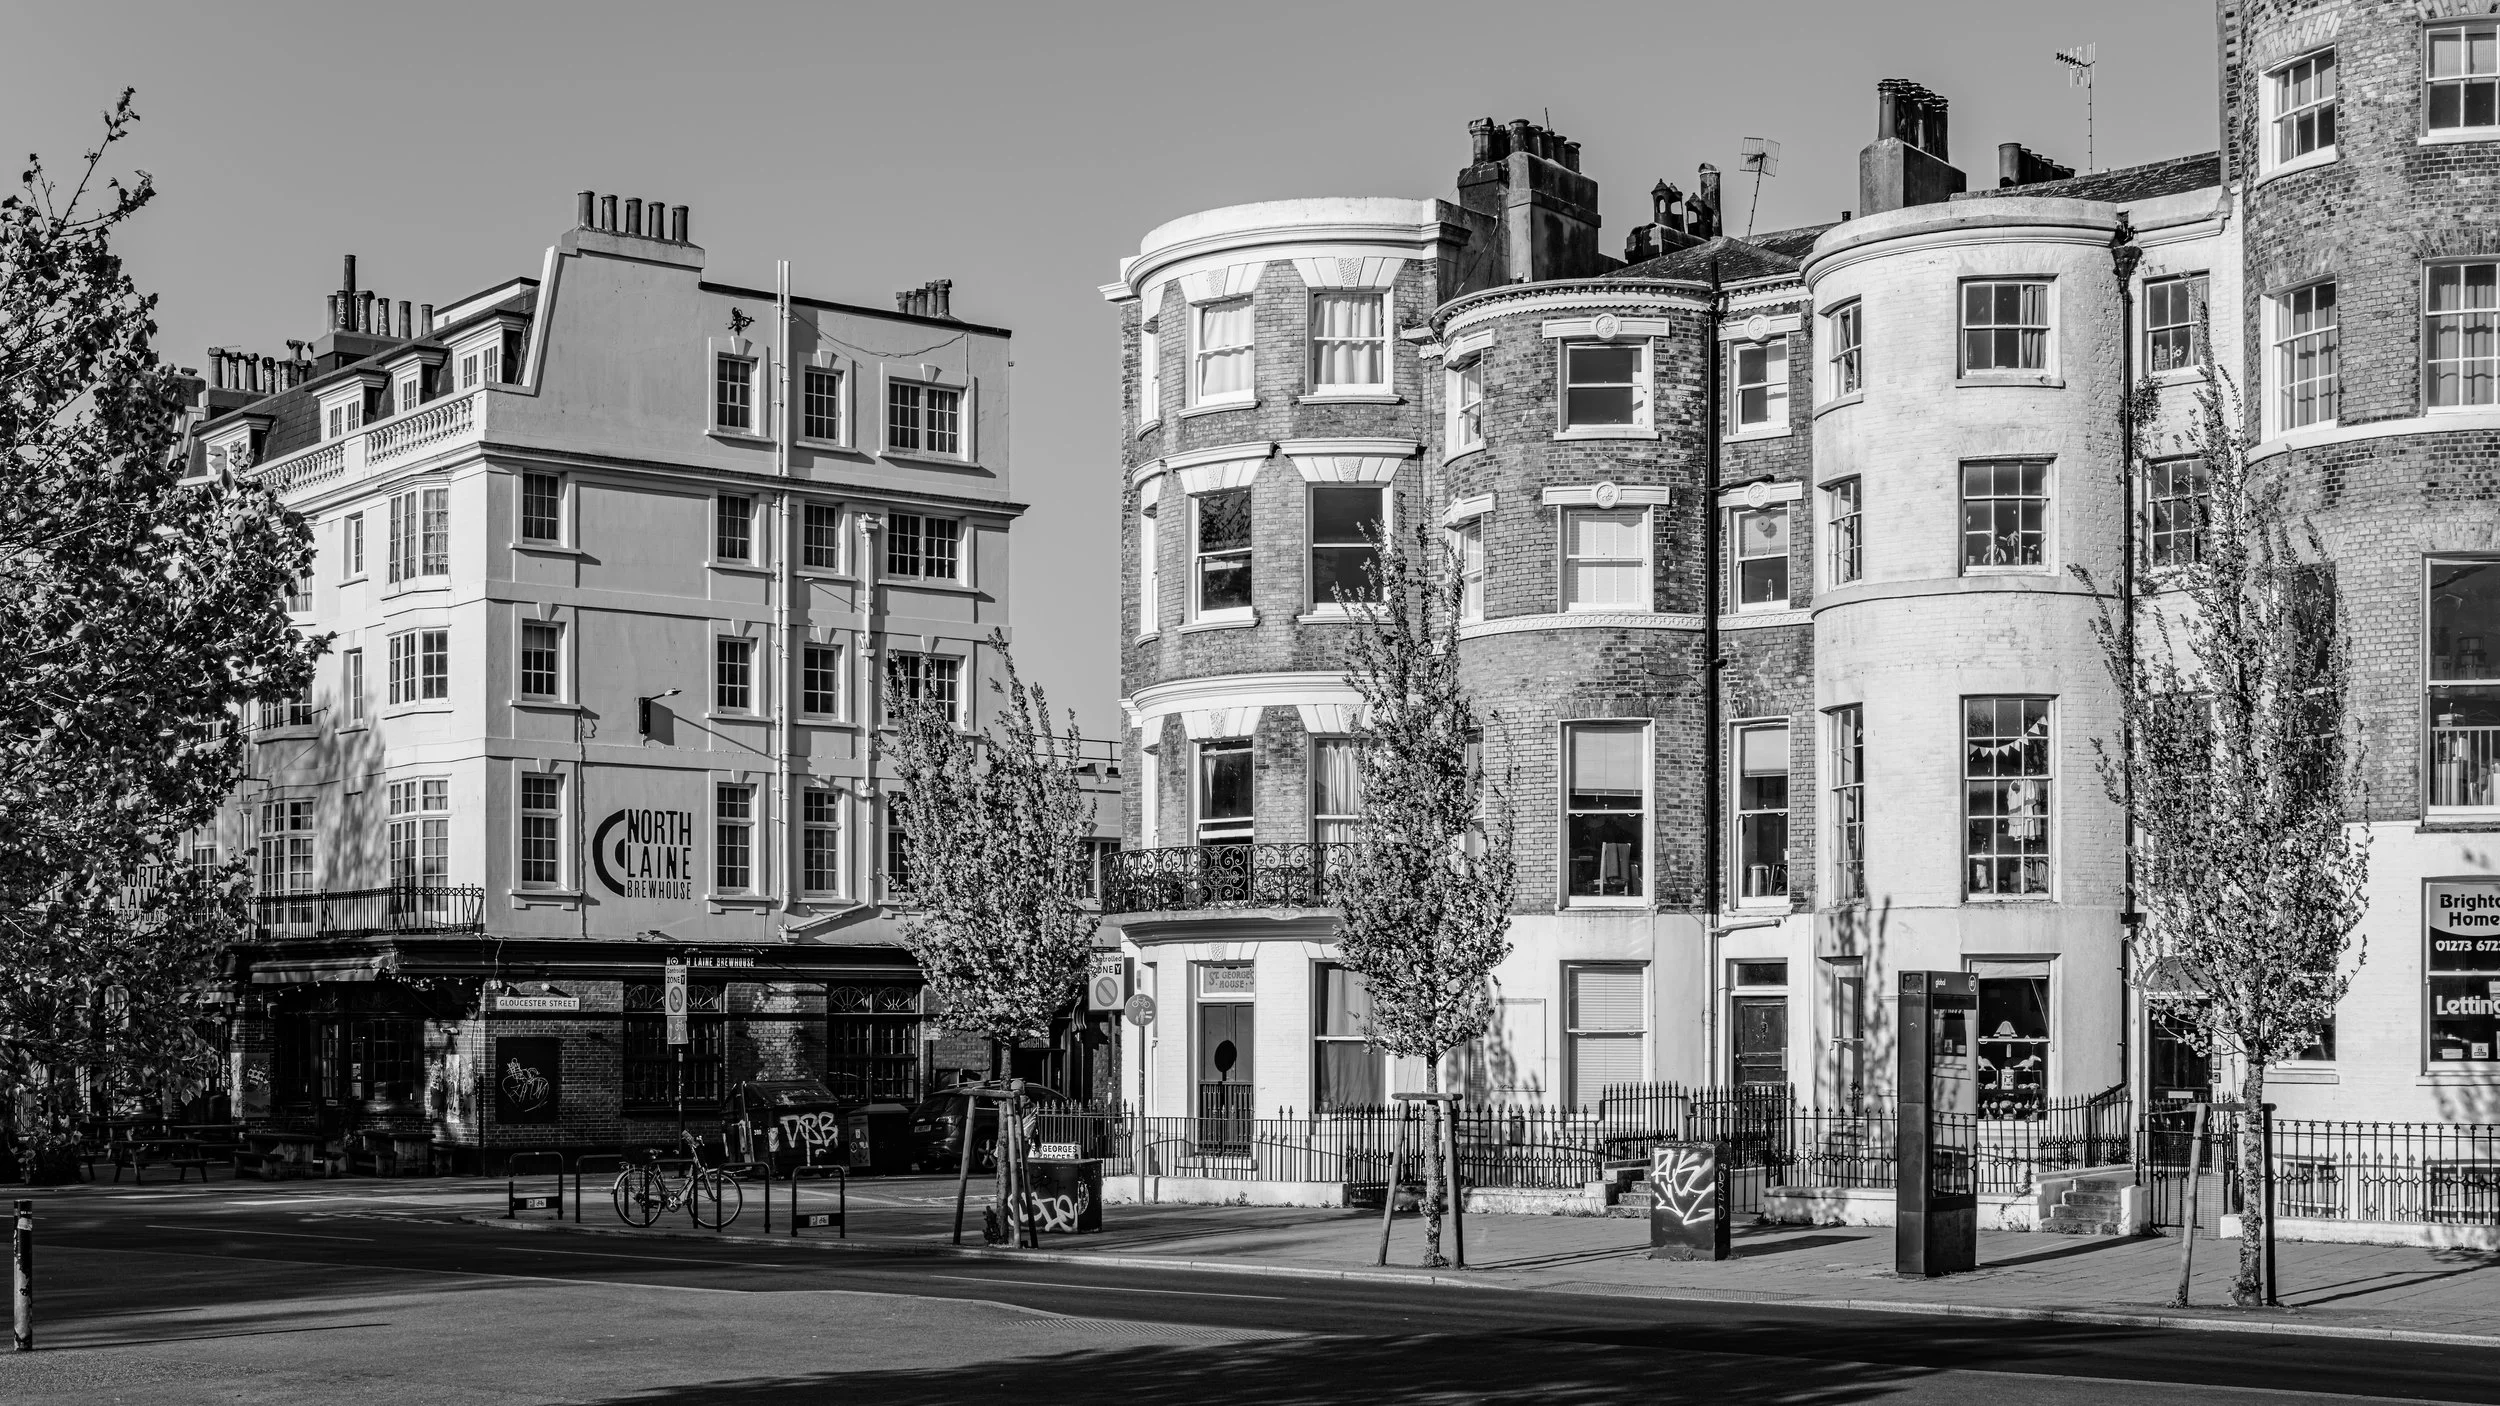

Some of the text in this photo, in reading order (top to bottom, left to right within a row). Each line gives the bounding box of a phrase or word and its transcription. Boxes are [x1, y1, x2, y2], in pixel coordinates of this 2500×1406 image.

[628, 809, 691, 846] NORTH
[628, 845, 691, 880] LAINE
[628, 880, 691, 899] BREWHOUSE
[119, 888, 163, 909] LAIN
[2449, 912, 2500, 928] Home
[2435, 940, 2472, 951] 01273
[694, 957, 713, 967] LAINE
[717, 957, 754, 967] BREWHOUSE
[1219, 980, 1244, 988] HOUSE
